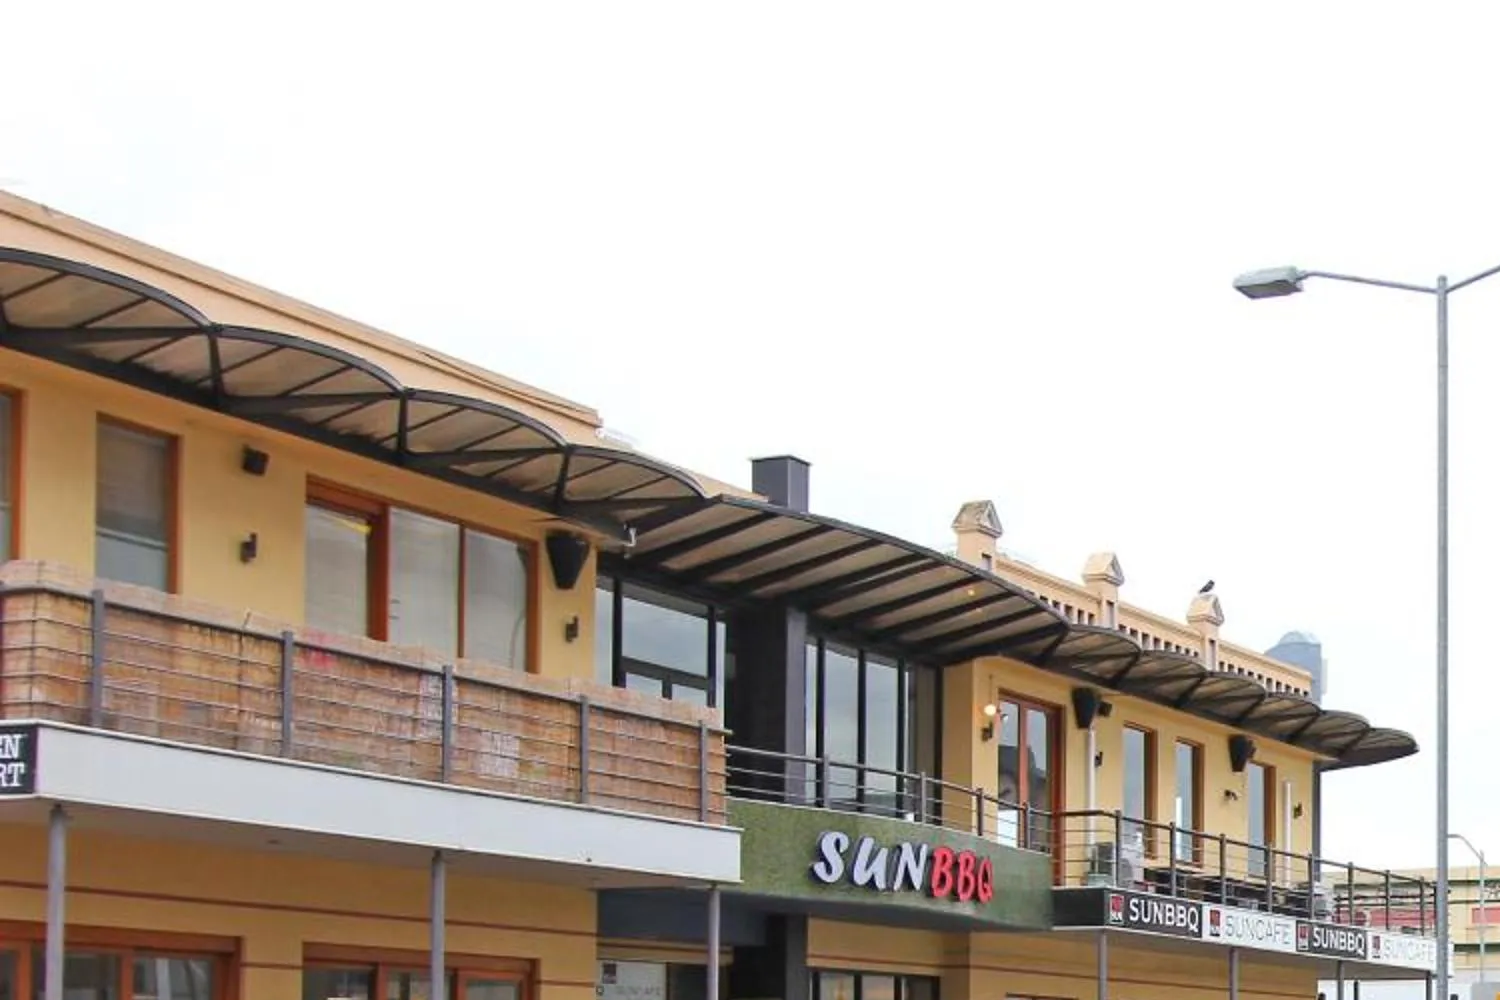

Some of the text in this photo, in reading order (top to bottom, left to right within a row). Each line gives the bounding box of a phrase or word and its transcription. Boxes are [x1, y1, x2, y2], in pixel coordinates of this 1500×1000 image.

[812, 831, 994, 904] SUNBBQ
[1129, 898, 1199, 933] SUNBBQ
[1226, 915, 1291, 945] SUNCAFE
[1313, 927, 1365, 956] SUNBBQ
